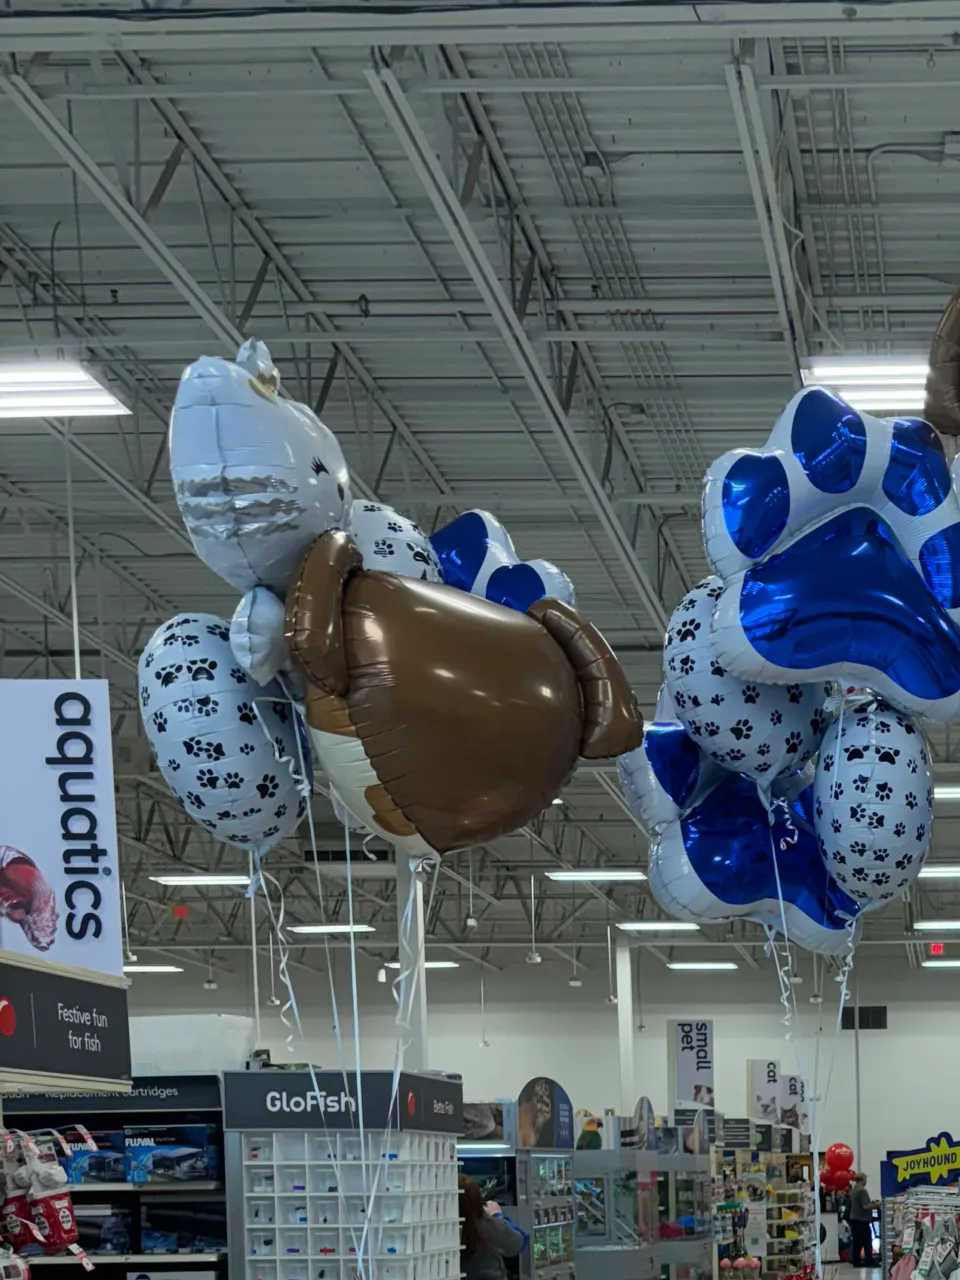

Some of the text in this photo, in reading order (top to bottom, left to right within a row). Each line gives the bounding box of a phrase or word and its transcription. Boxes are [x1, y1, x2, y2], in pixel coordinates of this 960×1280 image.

[45, 691, 108, 940] aquatics
[57, 1003, 108, 1028] Festive fun
[68, 1030, 101, 1052] for fish
[677, 1022, 696, 1052] pet
[695, 1022, 711, 1071] small
[767, 1061, 778, 1084] cat
[788, 1076, 799, 1096] cat
[266, 1091, 356, 1113] GloFish
[67, 1142, 92, 1151] FLUVA
[125, 1137, 156, 1147] FLUVAL
[902, 1153, 958, 1172] JOYHOUND
